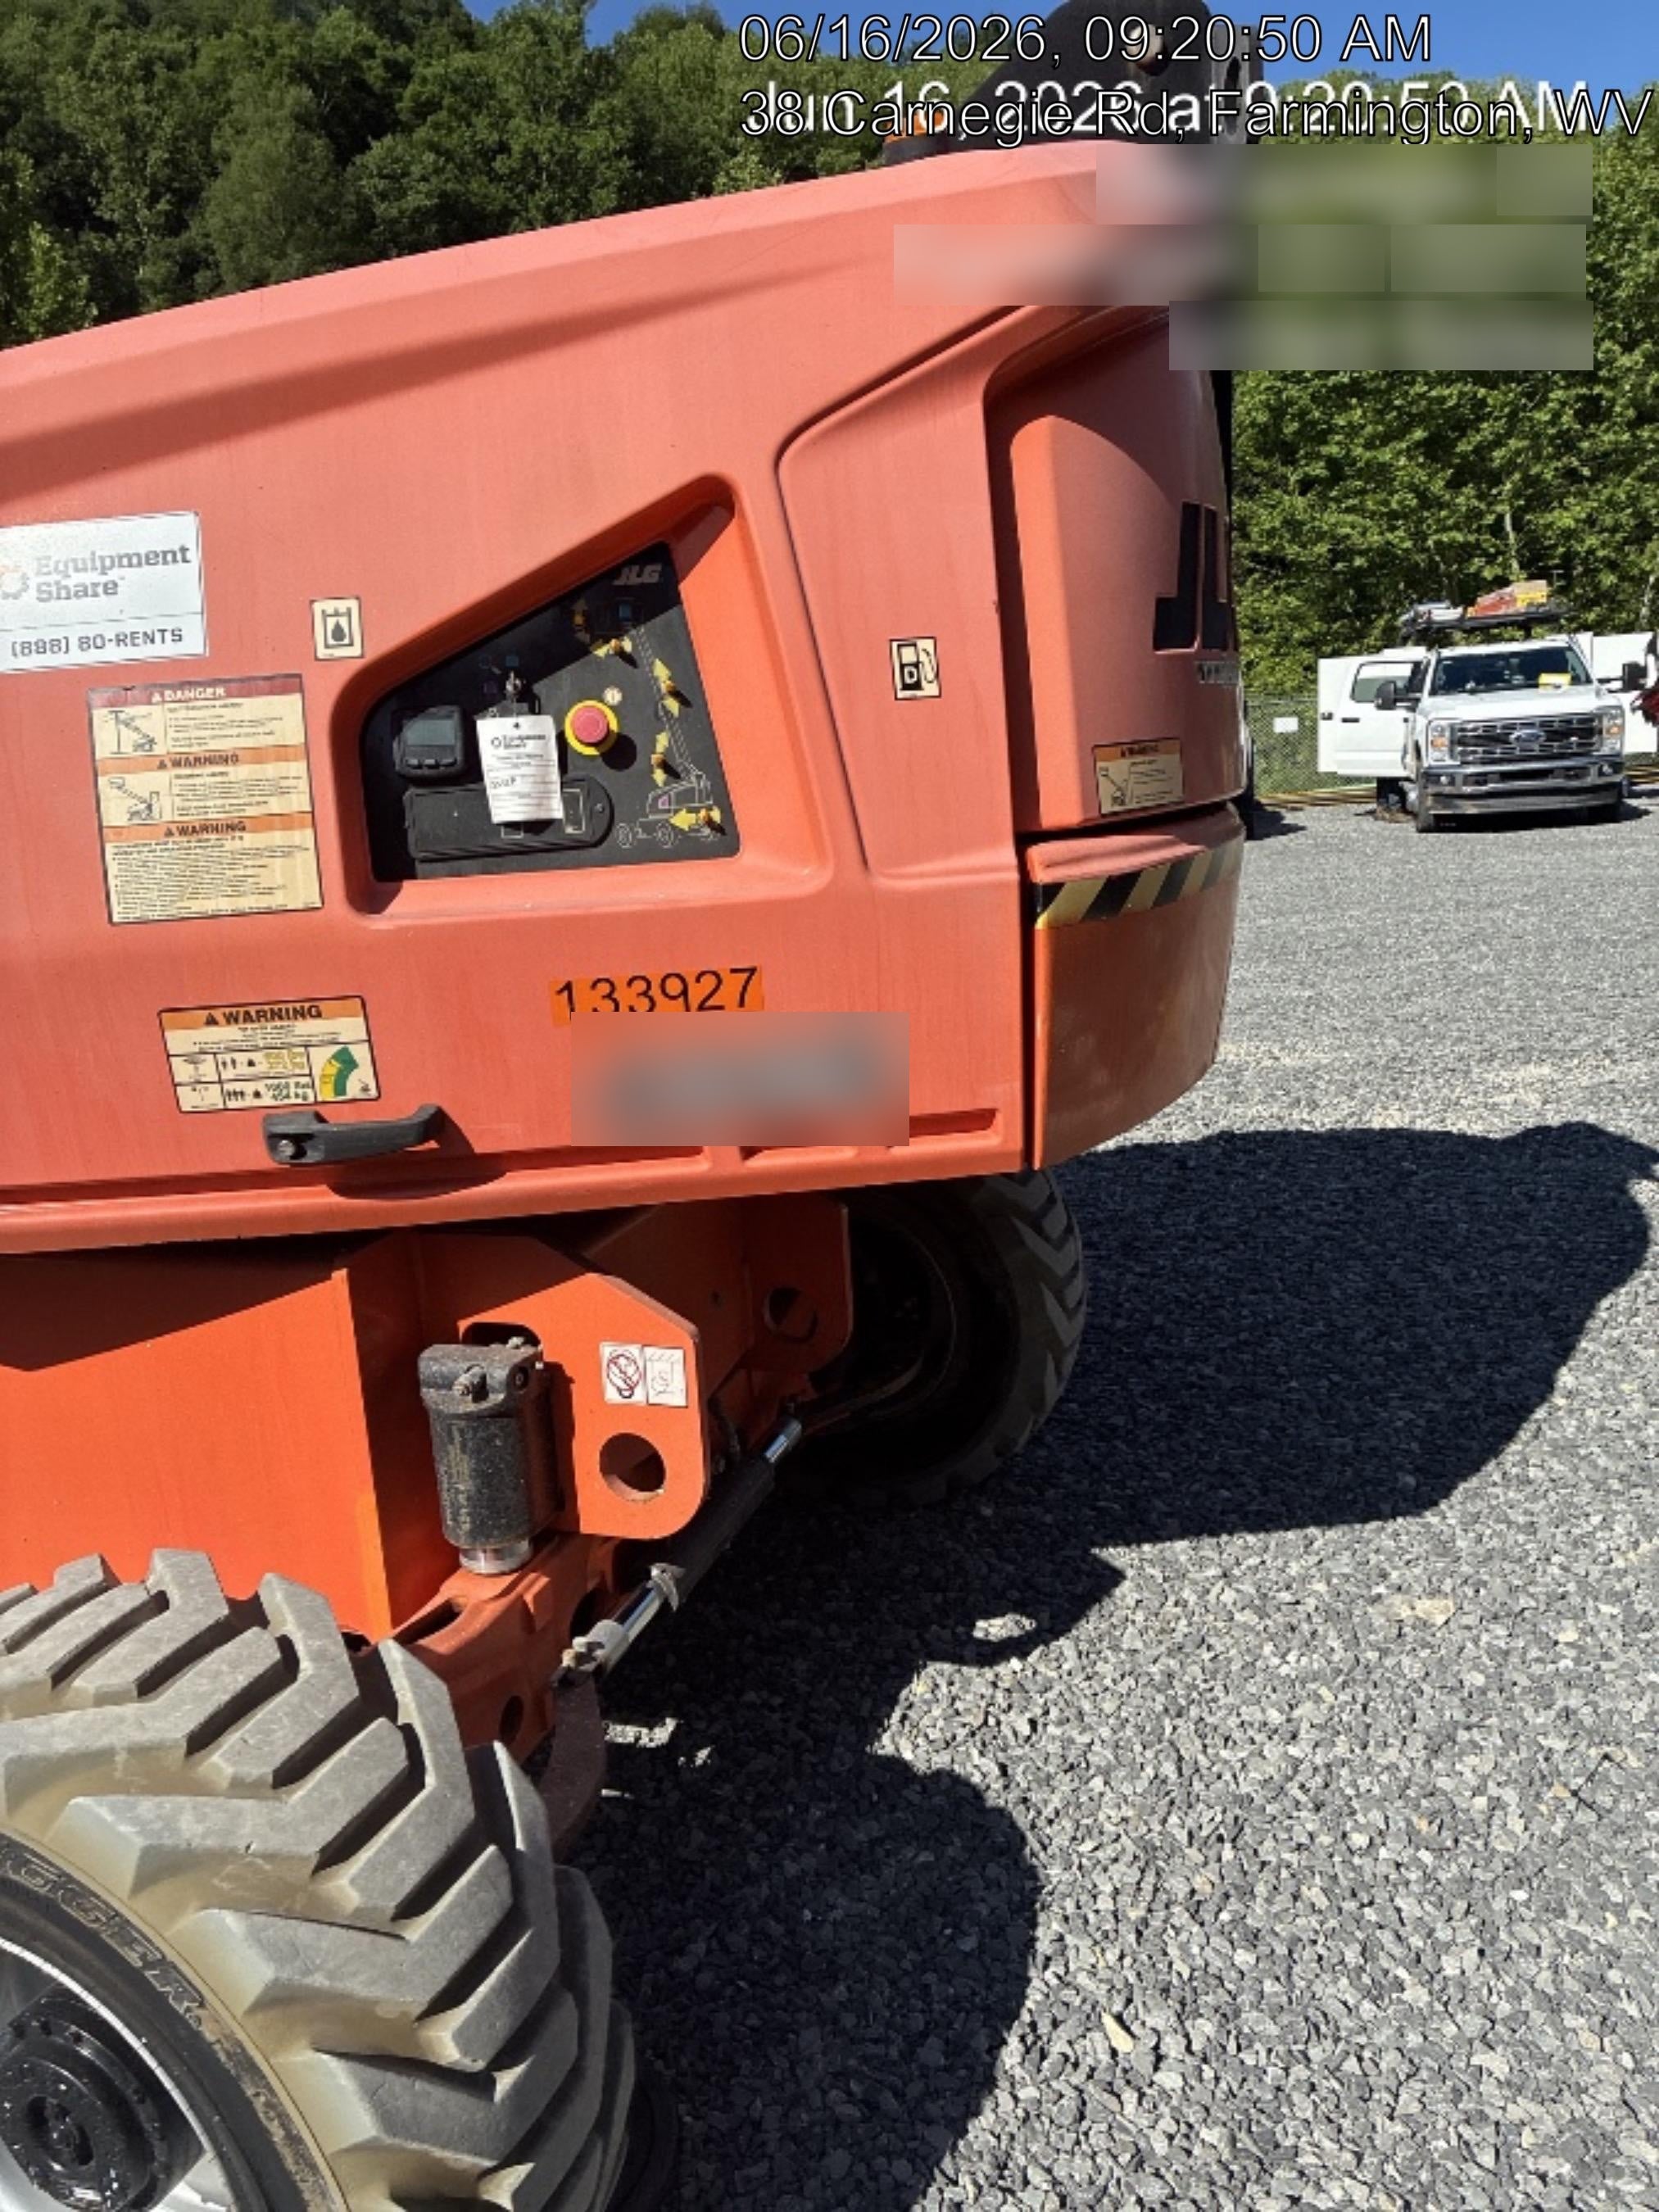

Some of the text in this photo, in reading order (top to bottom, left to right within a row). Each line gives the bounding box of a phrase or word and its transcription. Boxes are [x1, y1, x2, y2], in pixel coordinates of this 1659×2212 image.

[34, 544, 192, 578] Equipment
[36, 578, 119, 603] Share
[166, 687, 226, 703] DANGER
[170, 753, 240, 769] WARNING
[175, 820, 246, 837] WARNING
[555, 966, 758, 1017] 133927
[222, 1004, 323, 1025] WARNING
